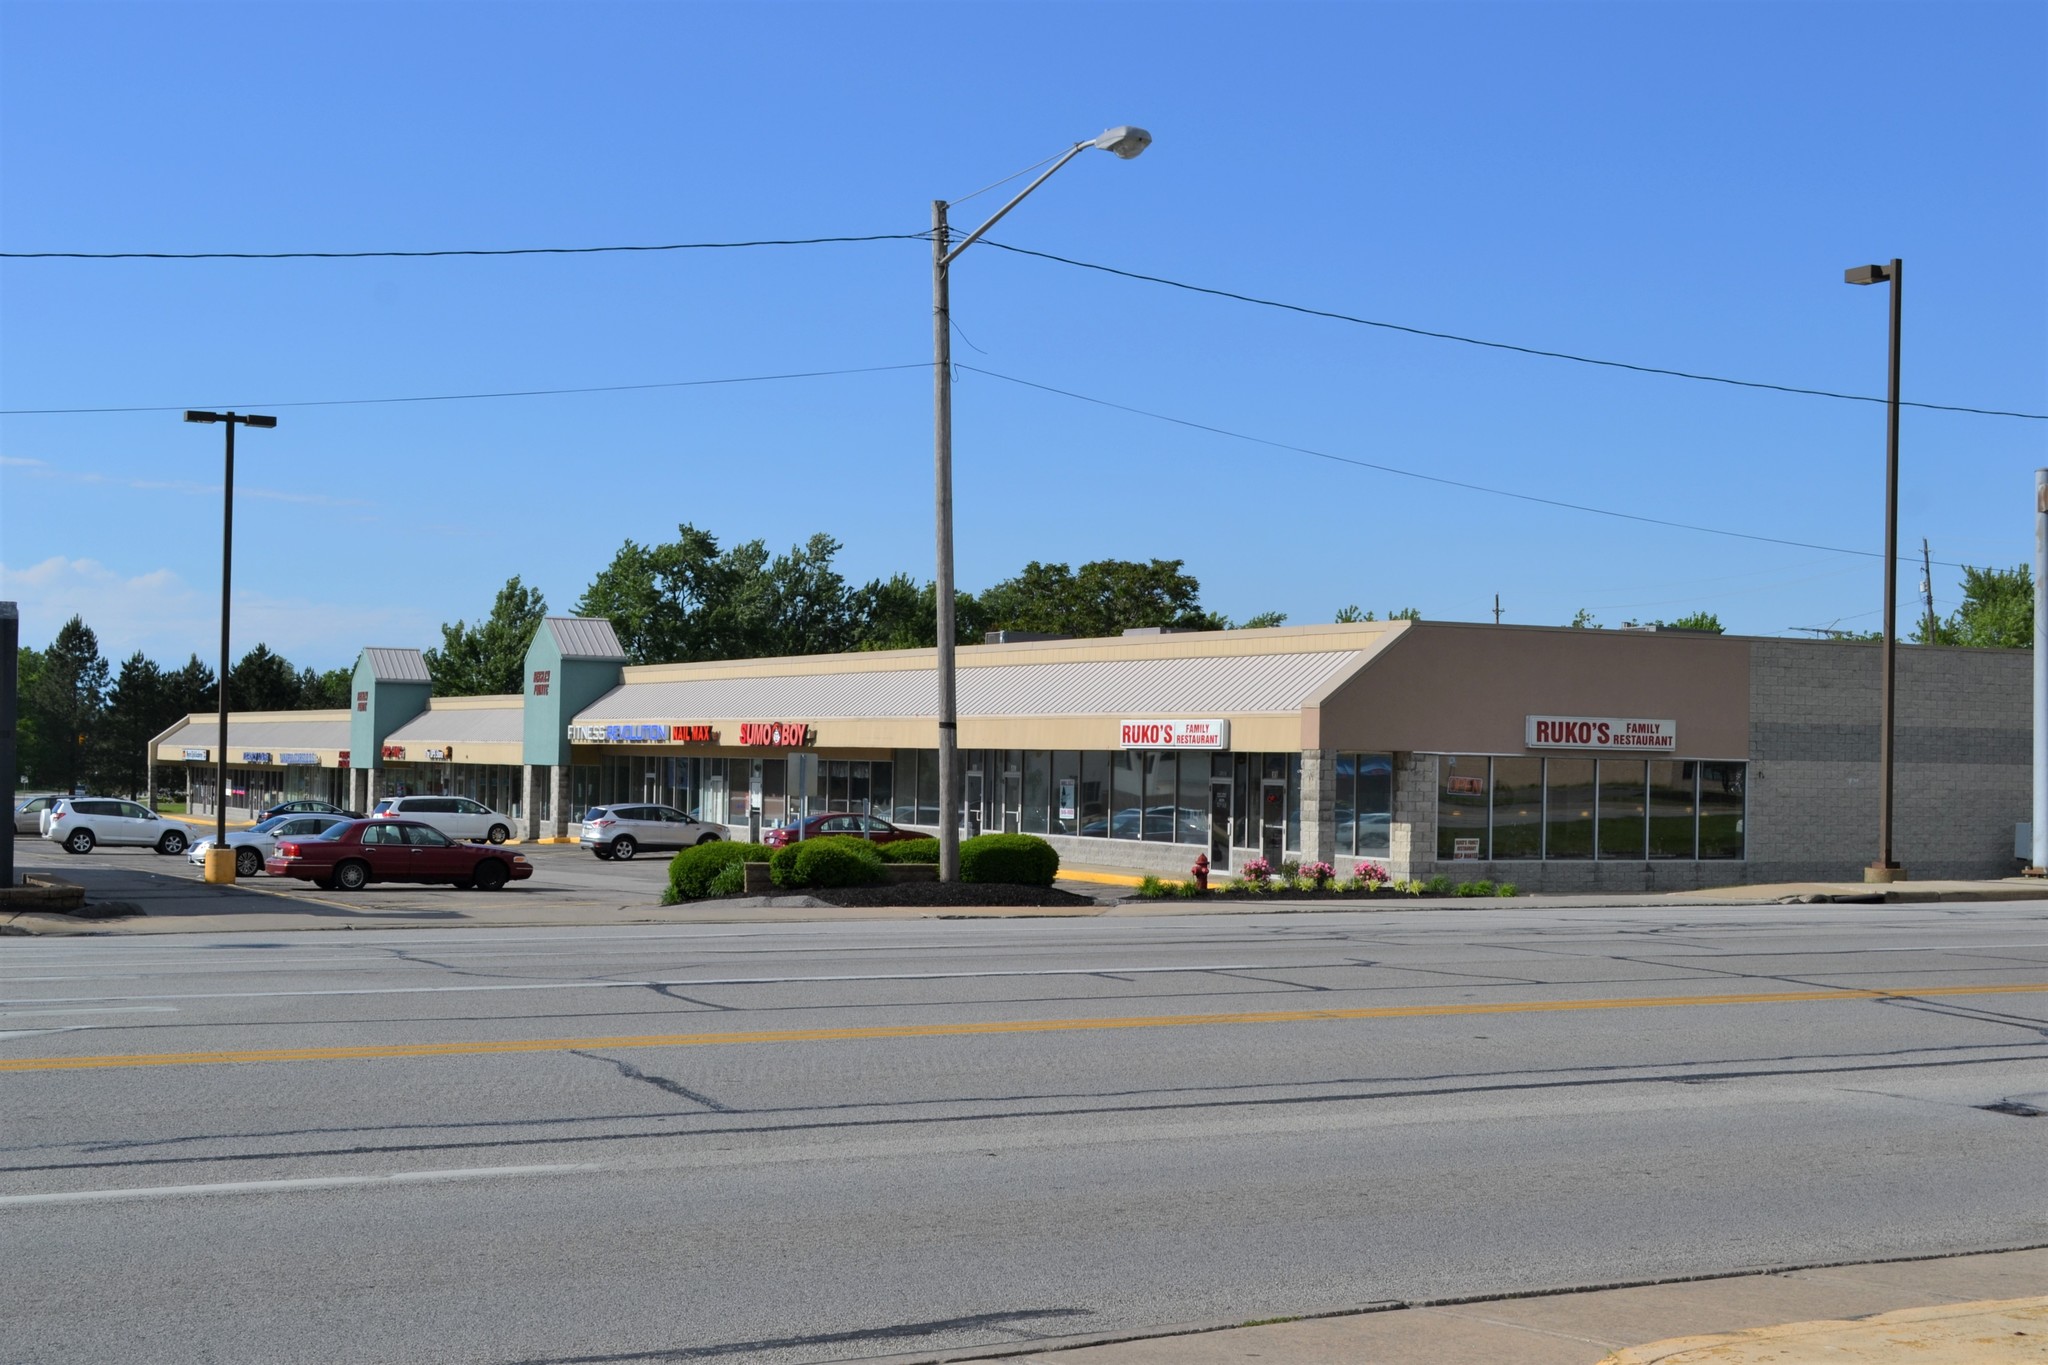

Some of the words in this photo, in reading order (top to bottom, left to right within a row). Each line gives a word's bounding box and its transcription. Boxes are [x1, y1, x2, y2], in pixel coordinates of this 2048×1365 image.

[567, 725, 606, 740] FITNESS
[606, 725, 668, 741] REVOLUTION
[672, 726, 690, 741] NAIL
[691, 726, 711, 741] MAX
[740, 723, 771, 745] SUMO
[782, 724, 807, 746] BOY
[1122, 724, 1173, 744] RUKO'S
[1185, 724, 1210, 733] FAMILY
[1536, 720, 1610, 744] RUKO'S
[1626, 723, 1660, 734] FAMILY
[1176, 734, 1218, 744] RESTAURANT
[1613, 734, 1673, 746] RESTAURANT
[1449, 778, 1481, 793] OPEN
